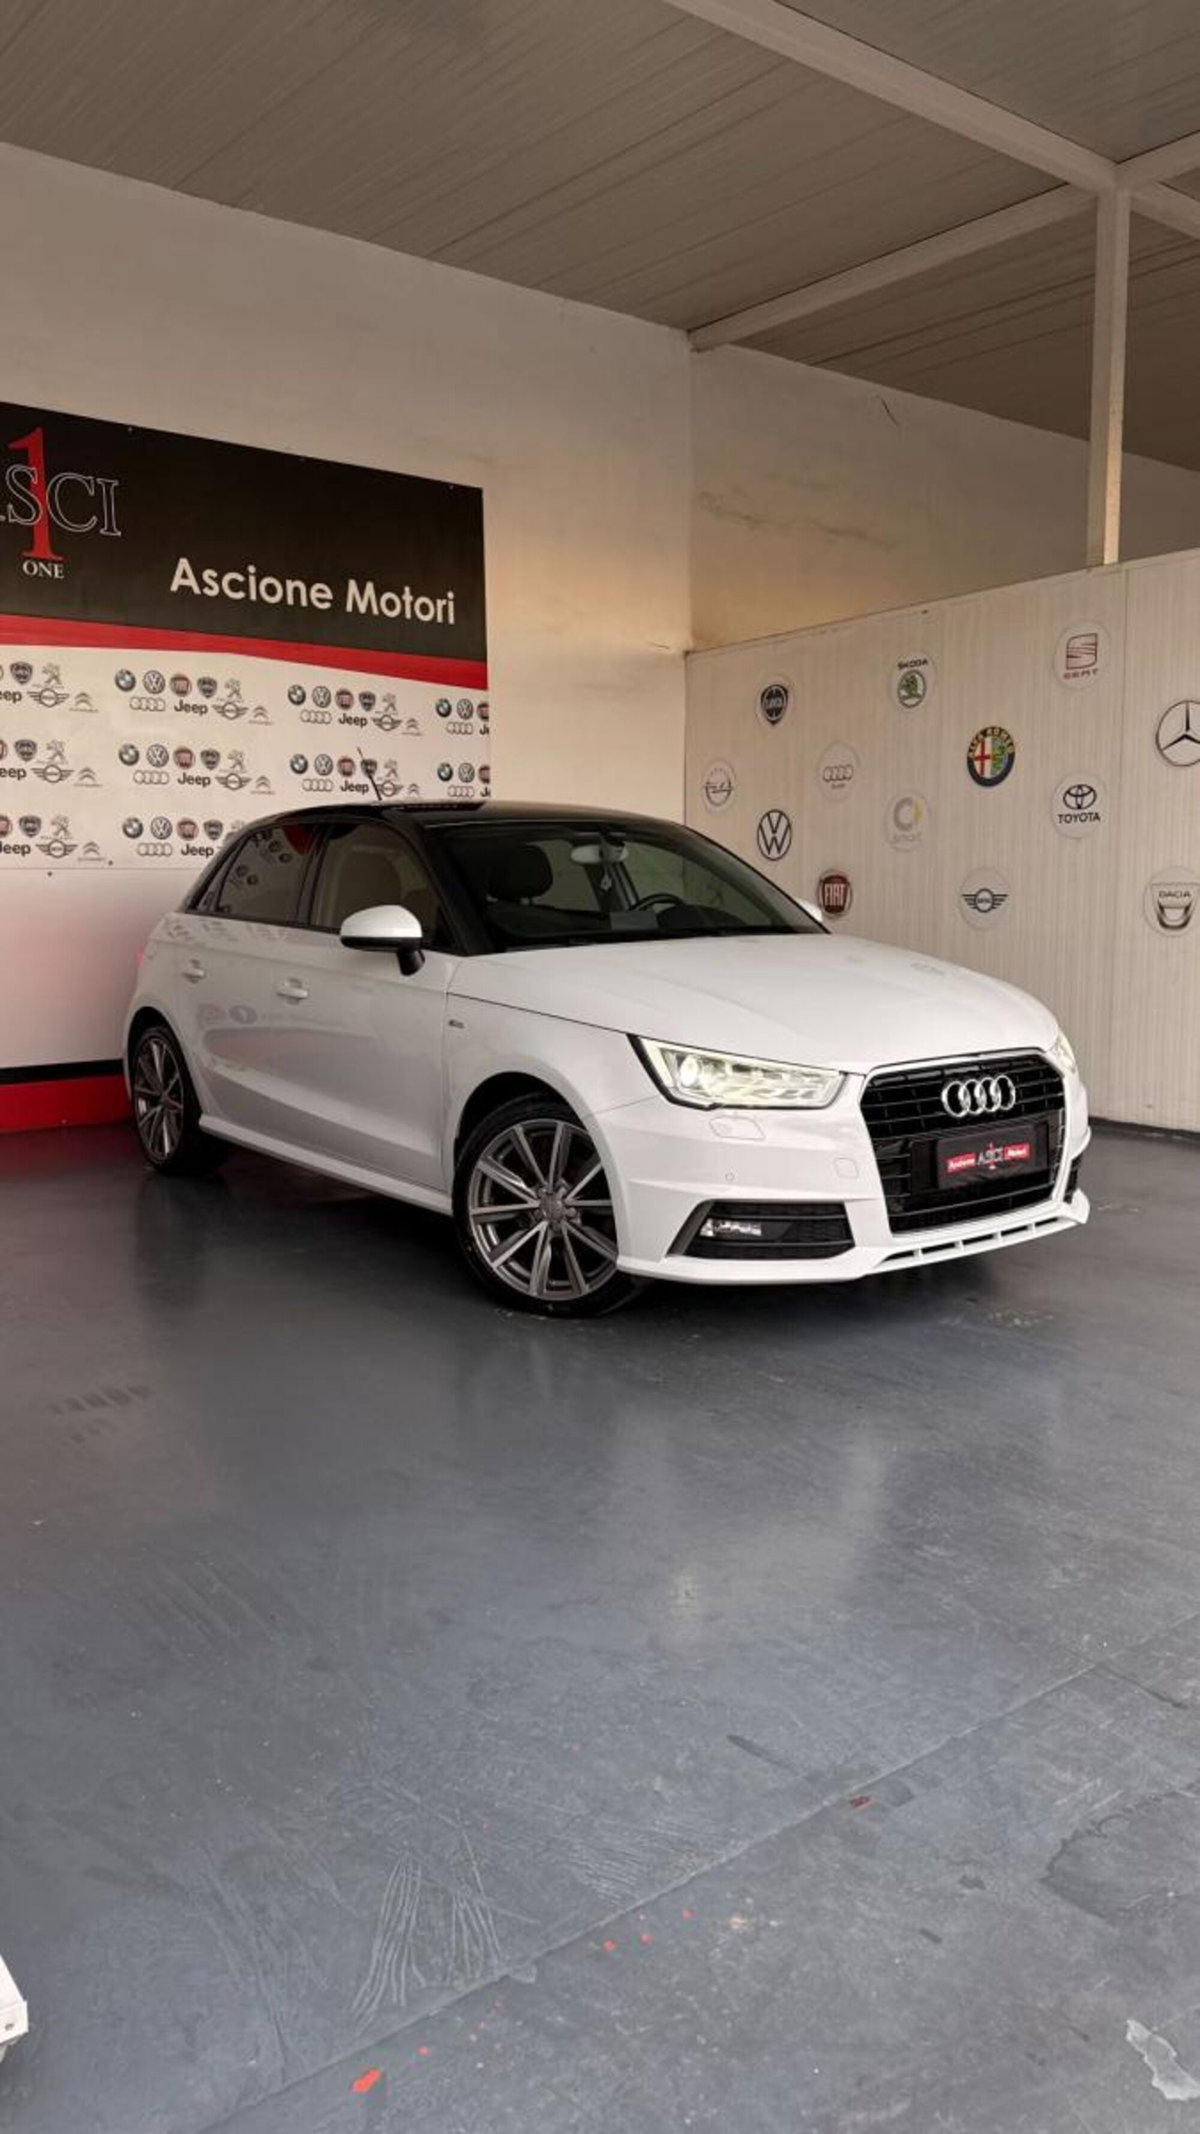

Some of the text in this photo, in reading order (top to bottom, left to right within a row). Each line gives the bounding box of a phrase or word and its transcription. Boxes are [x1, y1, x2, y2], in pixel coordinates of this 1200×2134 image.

[0, 464, 122, 537] SCI
[22, 560, 65, 579] ONE
[169, 557, 455, 625] Ascione Motori
[174, 700, 209, 717] Jeep
[338, 713, 368, 728] Jeep
[0, 767, 27, 781] eep
[177, 772, 212, 788] Jeep
[340, 780, 370, 795] Jeep
[1057, 811, 1102, 824] TOYOTA
[0, 840, 31, 857] eep
[181, 843, 215, 859] Jeep
[824, 883, 846, 906] FIAT
